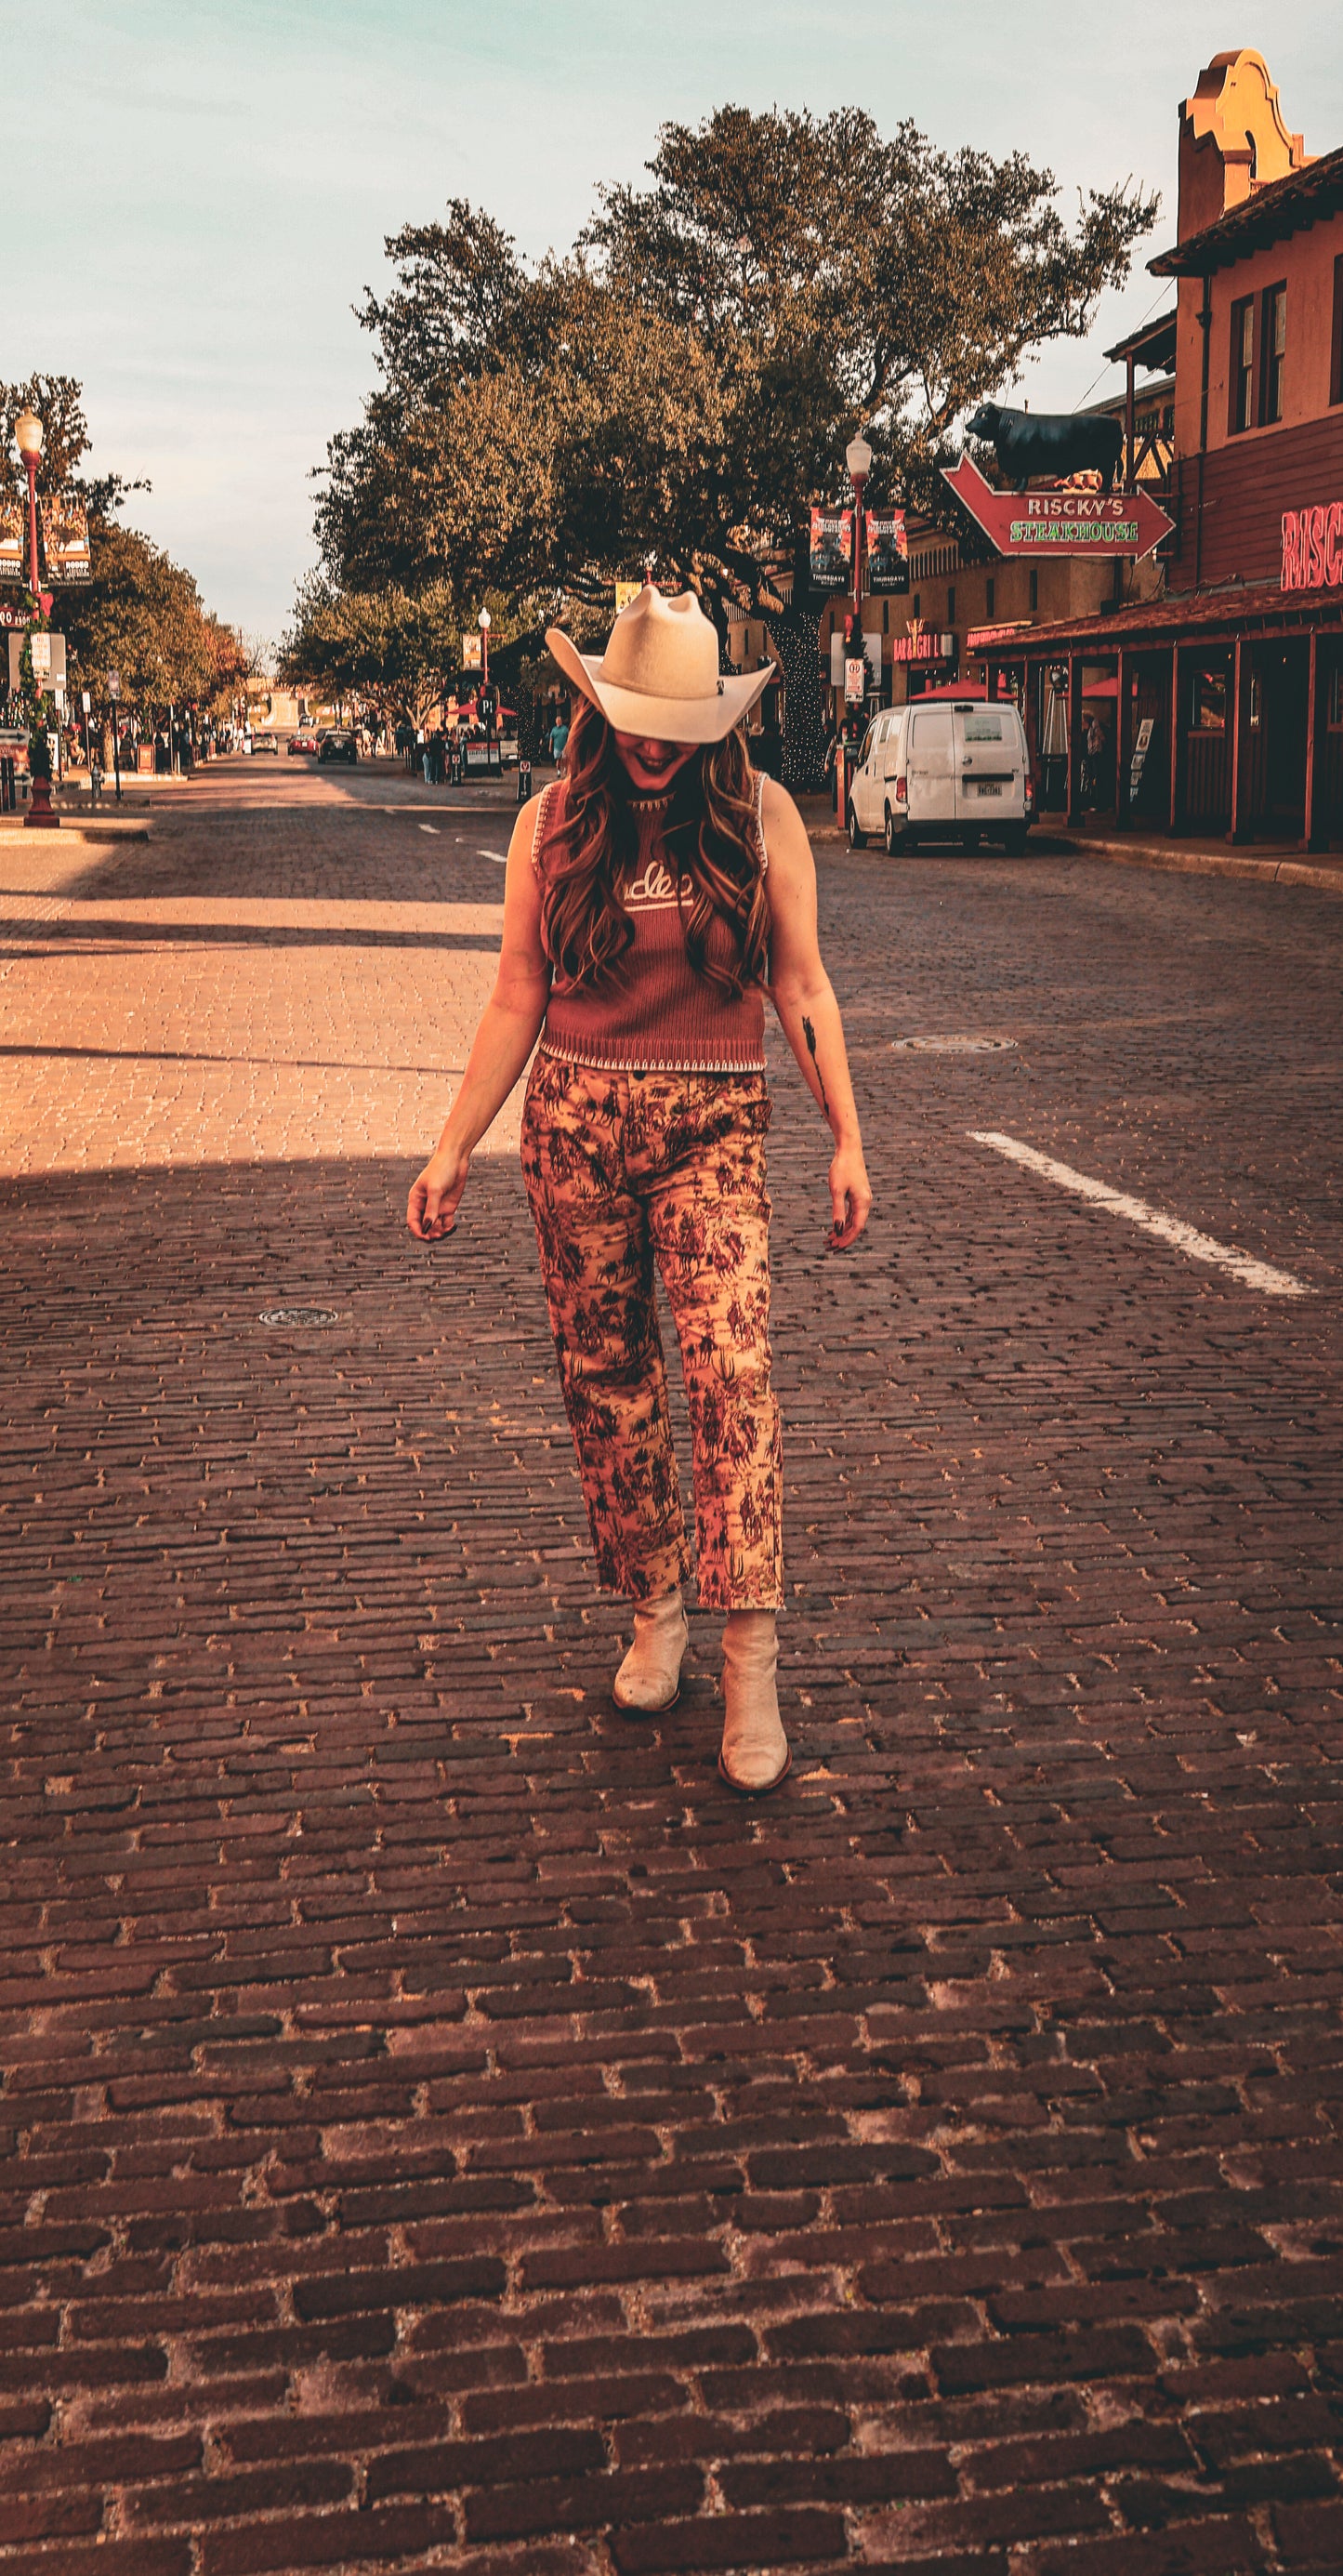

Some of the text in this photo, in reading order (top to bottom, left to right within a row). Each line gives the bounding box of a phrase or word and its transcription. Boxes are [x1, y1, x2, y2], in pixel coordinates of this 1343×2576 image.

[1028, 497, 1124, 516] RISCKY'S
[1009, 521, 1139, 543] STEAKHOUSE
[1281, 502, 1343, 591] RISC
[812, 574, 845, 583] THURSDAYS
[893, 638, 906, 662] BAR
[916, 633, 939, 659] GRIL
